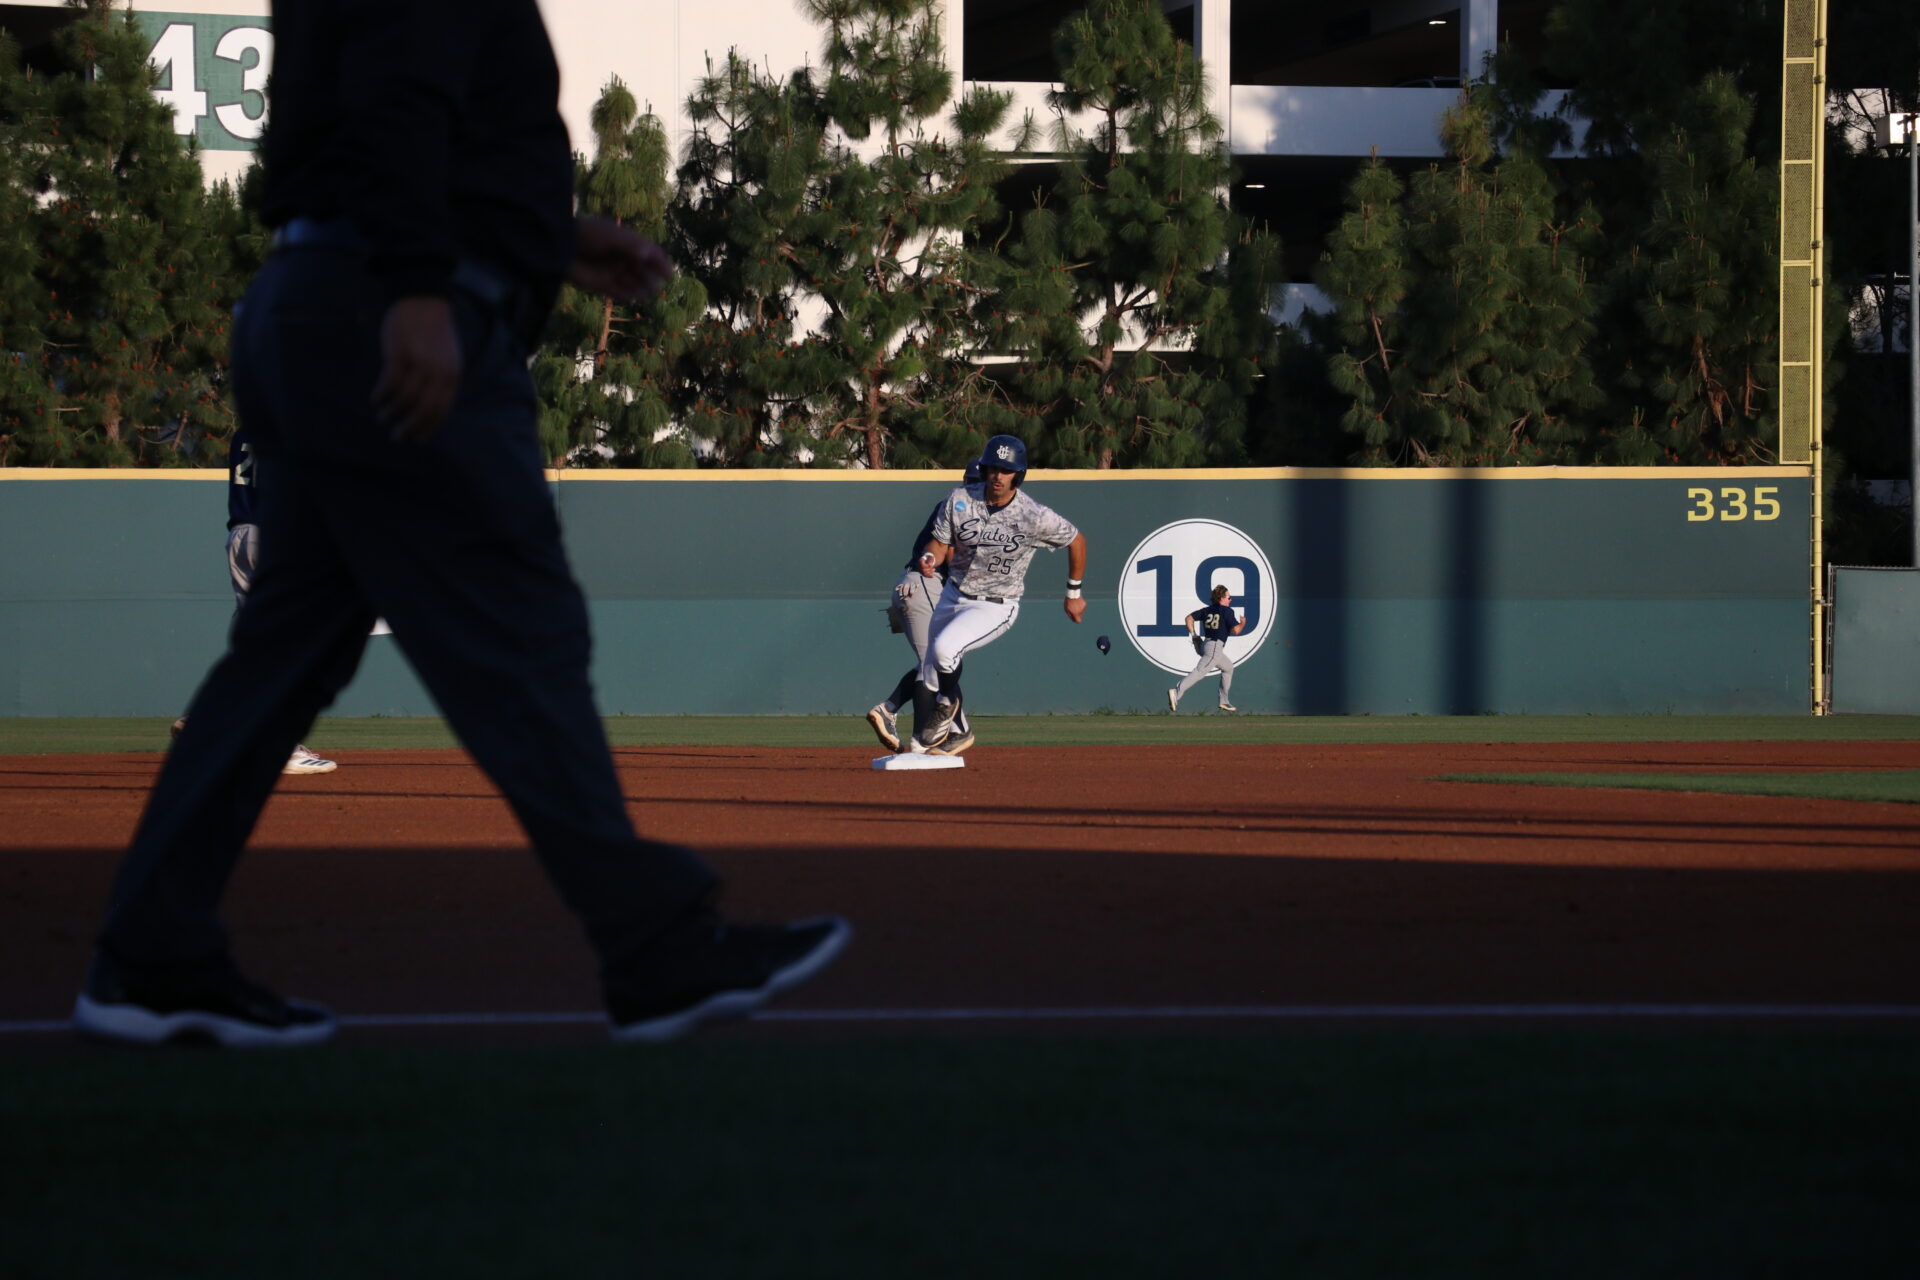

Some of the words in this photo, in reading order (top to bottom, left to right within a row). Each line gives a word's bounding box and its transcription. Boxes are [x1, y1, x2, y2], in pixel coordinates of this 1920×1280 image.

[146, 22, 275, 140] 43
[1687, 486, 1781, 521] 335
[987, 556, 1014, 575] 25
[1136, 555, 1260, 637] 19
[1205, 613, 1220, 630] 28
